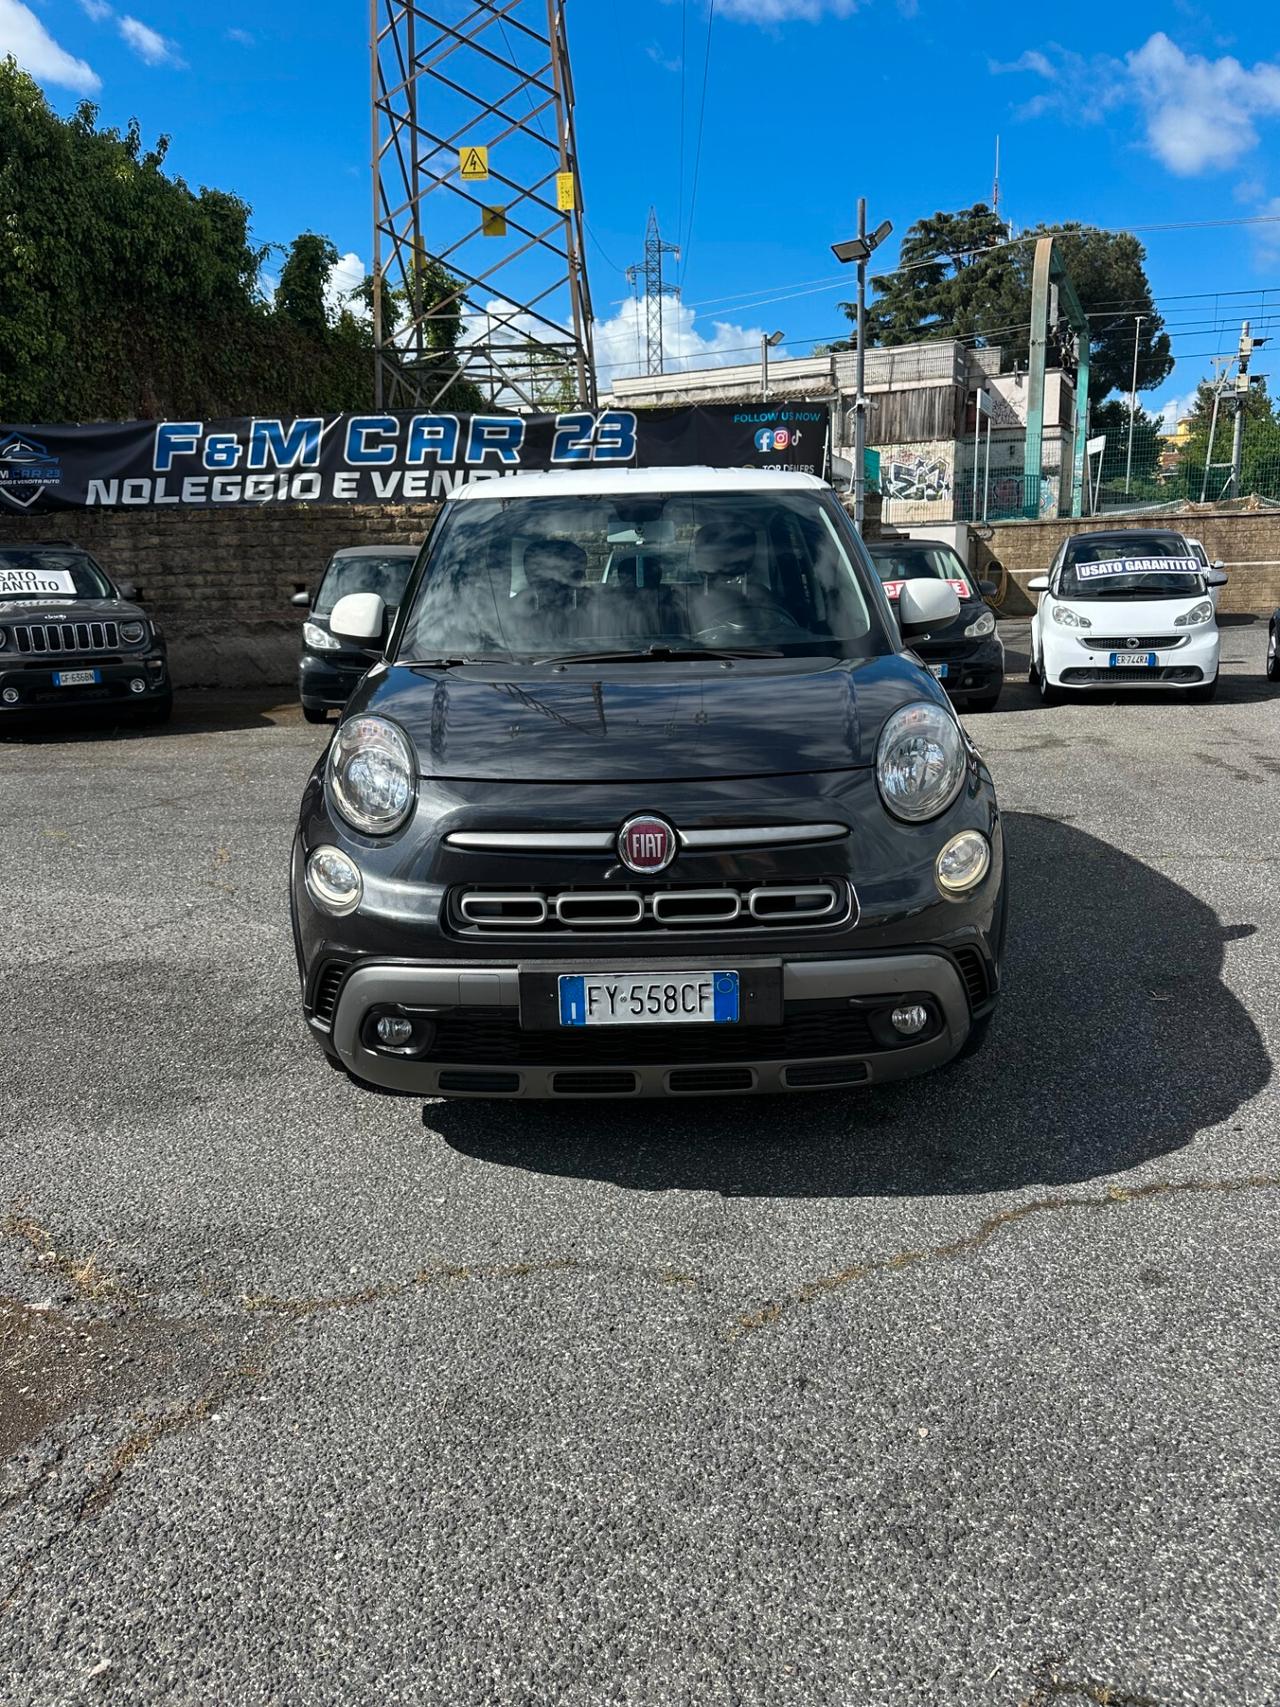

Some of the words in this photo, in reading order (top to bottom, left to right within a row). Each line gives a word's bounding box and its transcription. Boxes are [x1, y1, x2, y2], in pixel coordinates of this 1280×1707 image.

[734, 413, 778, 423] FOLLOW
[781, 412, 794, 421] US
[795, 412, 821, 421] NOW
[154, 418, 324, 471] F&M
[345, 414, 526, 465] CAR
[551, 411, 637, 462] 23
[85, 472, 321, 506] NOLEGGIO
[333, 472, 360, 498] E
[1081, 562, 1122, 576] USATO
[1125, 560, 1197, 571] GARANTITO
[0, 580, 60, 592] ANTITO
[631, 832, 664, 858] FIAT
